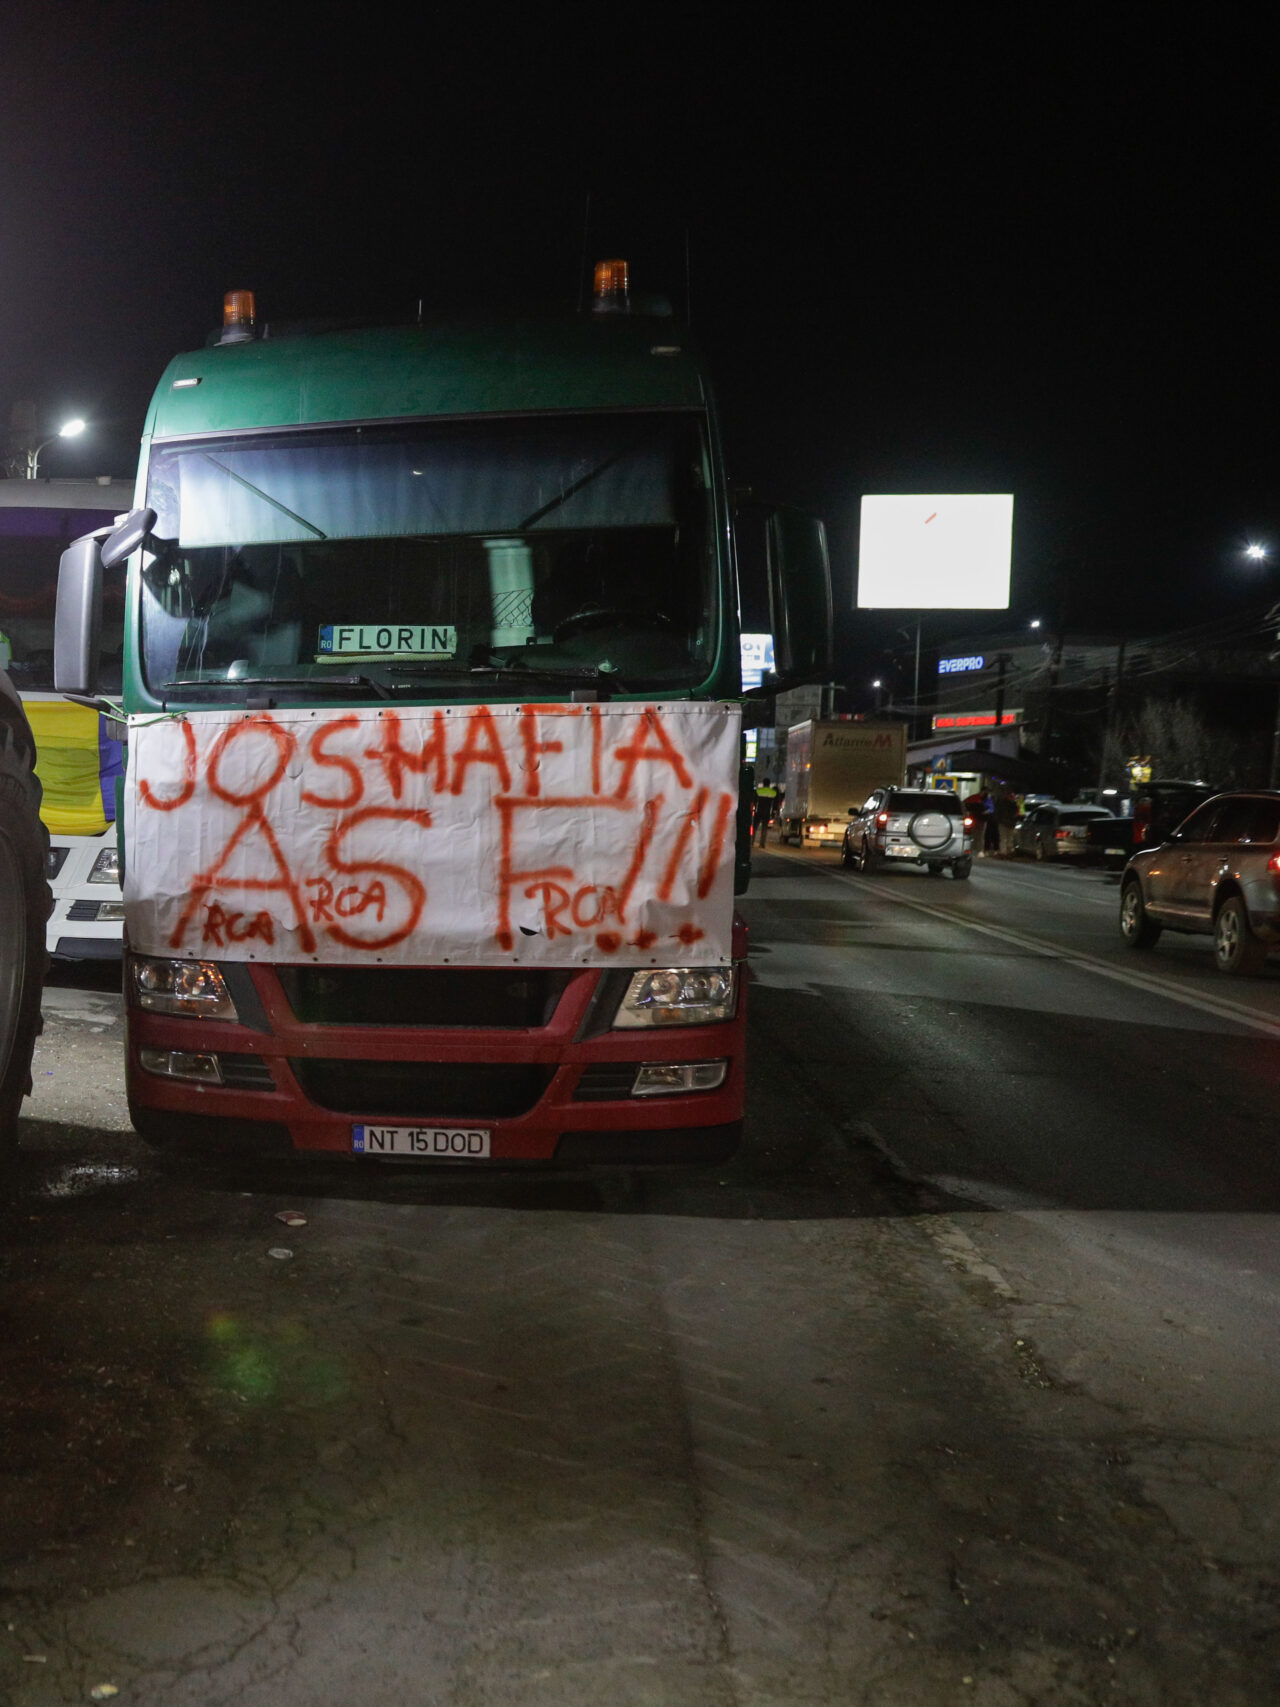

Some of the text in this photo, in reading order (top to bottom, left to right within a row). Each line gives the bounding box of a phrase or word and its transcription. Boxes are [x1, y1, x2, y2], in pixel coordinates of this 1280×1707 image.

[321, 628, 448, 650] RO FLORIN
[938, 656, 984, 674] EVERPRO
[140, 714, 364, 811] JOS
[306, 877, 386, 922] RCA
[203, 900, 274, 947] RCA
[354, 1130, 484, 1154] RO NT 15 DOD
